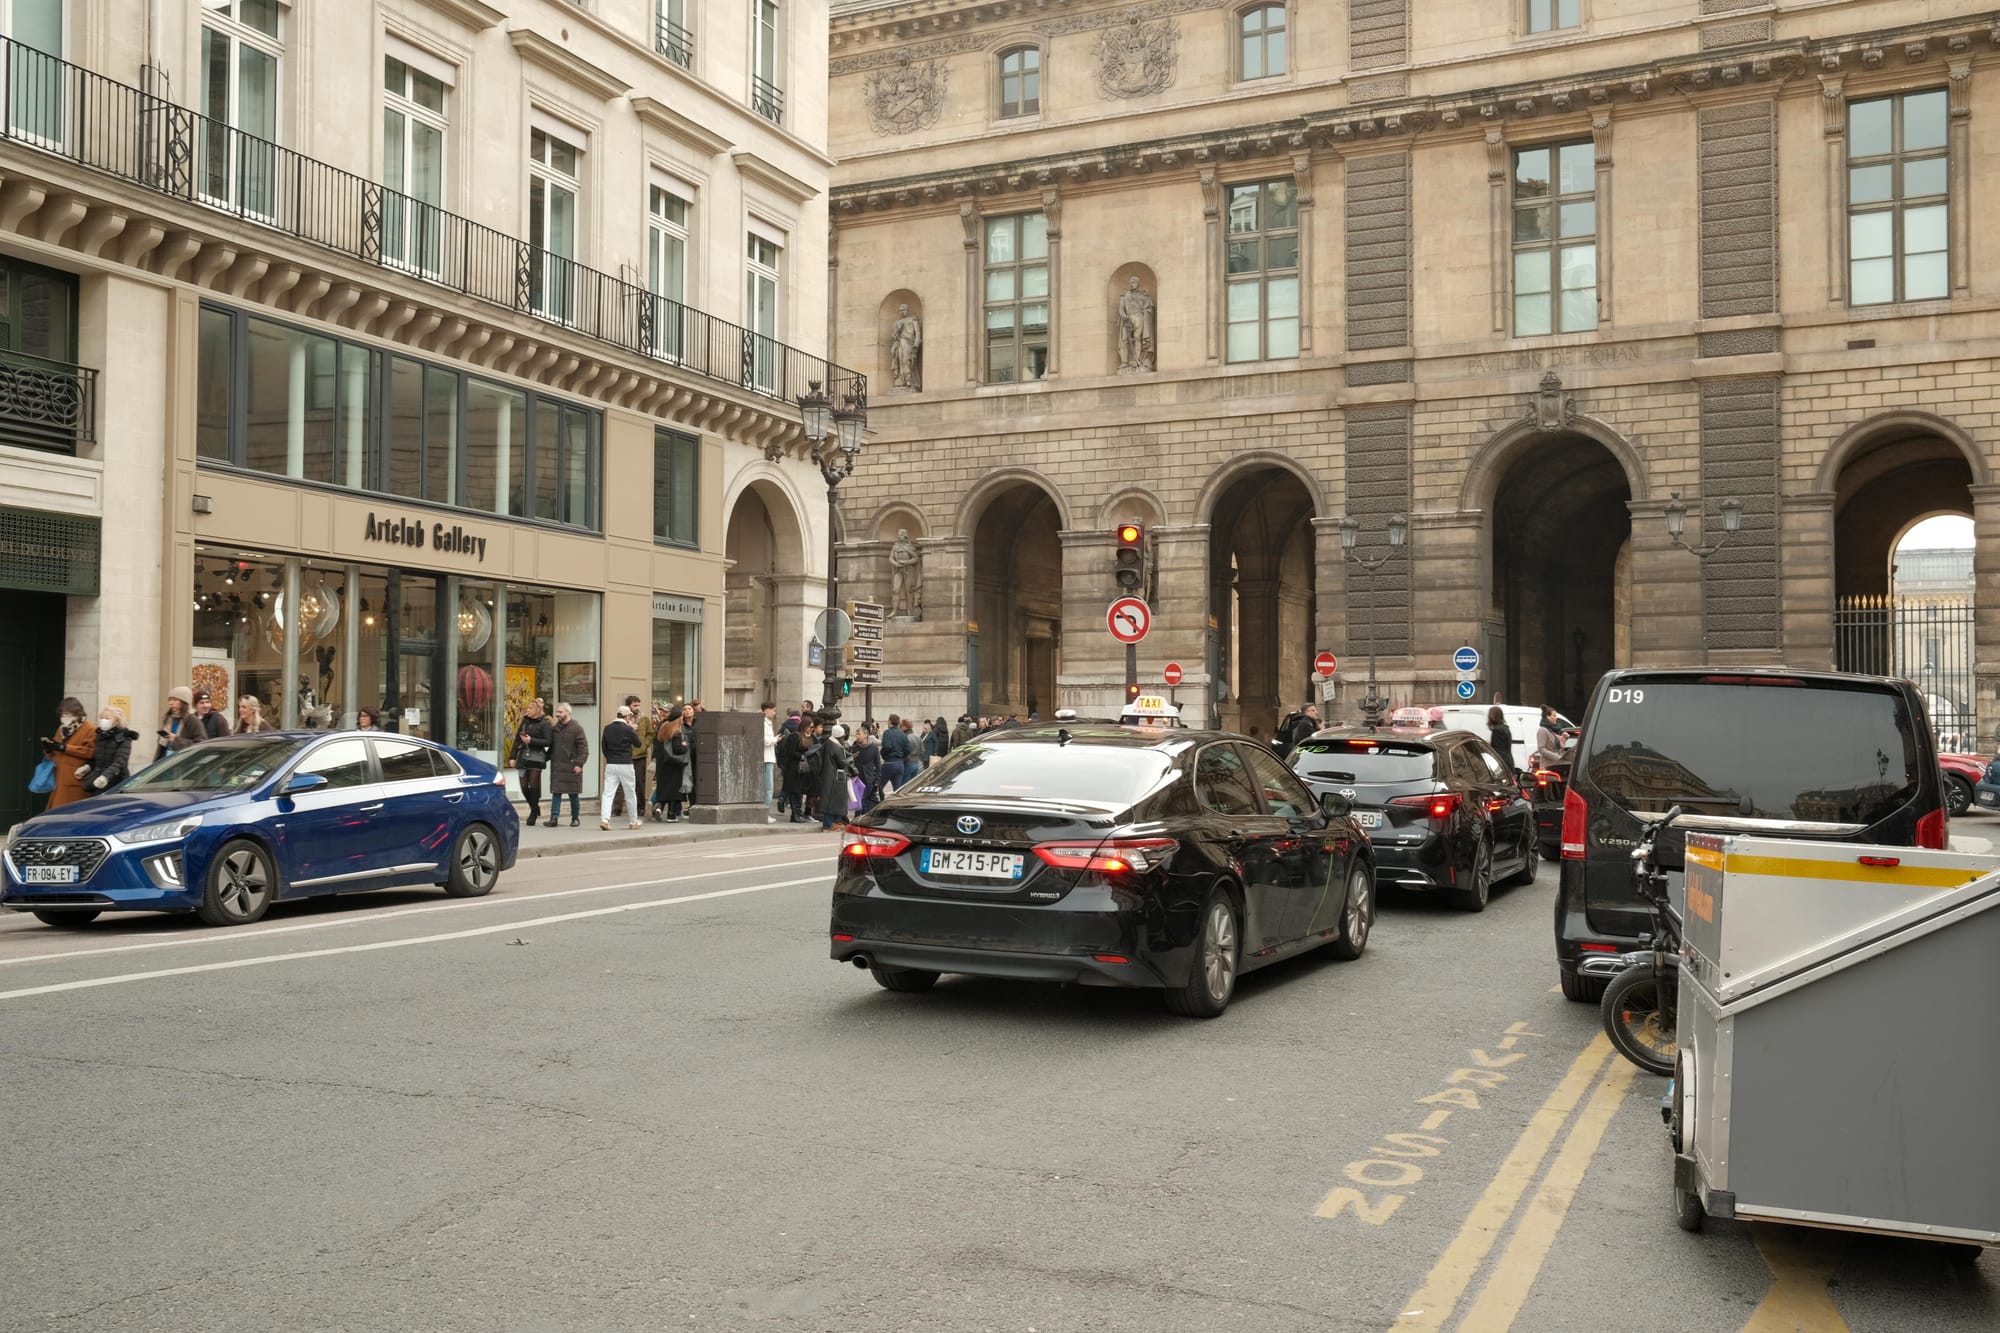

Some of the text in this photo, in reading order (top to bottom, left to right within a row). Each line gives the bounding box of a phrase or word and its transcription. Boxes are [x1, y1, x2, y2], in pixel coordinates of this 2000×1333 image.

[1468, 346, 1640, 374] PAVILLON DE ROHAN
[365, 512, 486, 562] Artclub Gallery
[1139, 698, 1161, 708] TAXI
[1609, 689, 1644, 704] D19
[929, 837, 1010, 846] CAMRY
[932, 852, 1010, 873] GM-215-PC
[27, 868, 71, 881] FR-094-EY
[1013, 867, 1022, 877] 75
